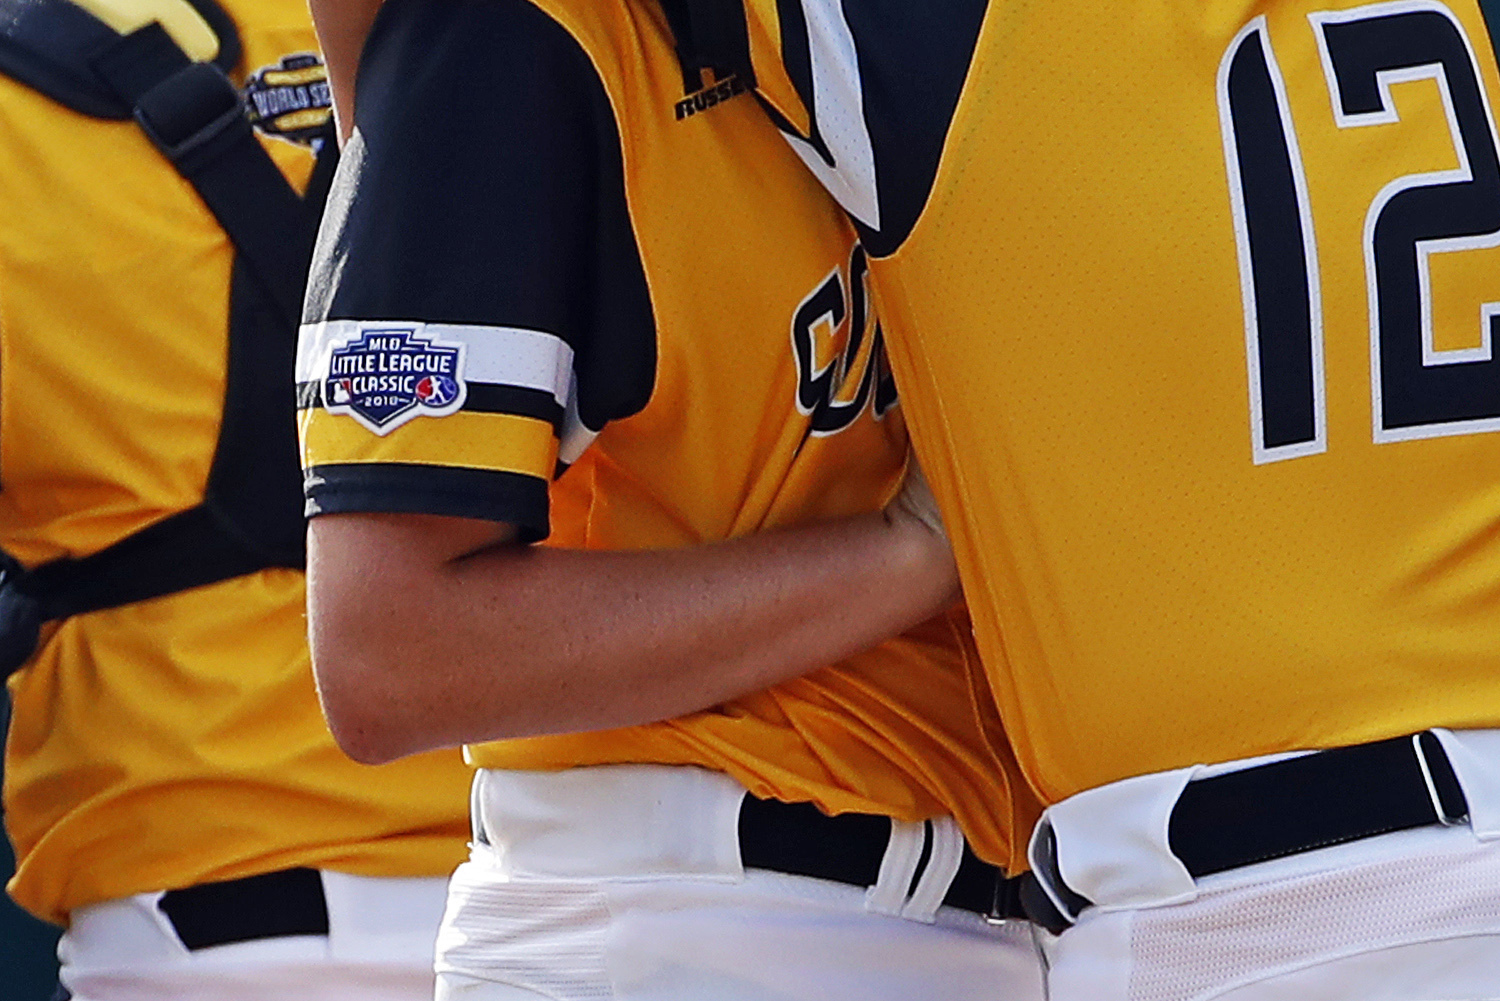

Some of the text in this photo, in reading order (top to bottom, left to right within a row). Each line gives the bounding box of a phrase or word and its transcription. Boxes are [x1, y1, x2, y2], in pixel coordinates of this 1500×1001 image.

[251, 86, 310, 118] WORLD
[331, 352, 452, 375] LITTLE LEAGUE
[352, 375, 416, 395] CLASSIC
